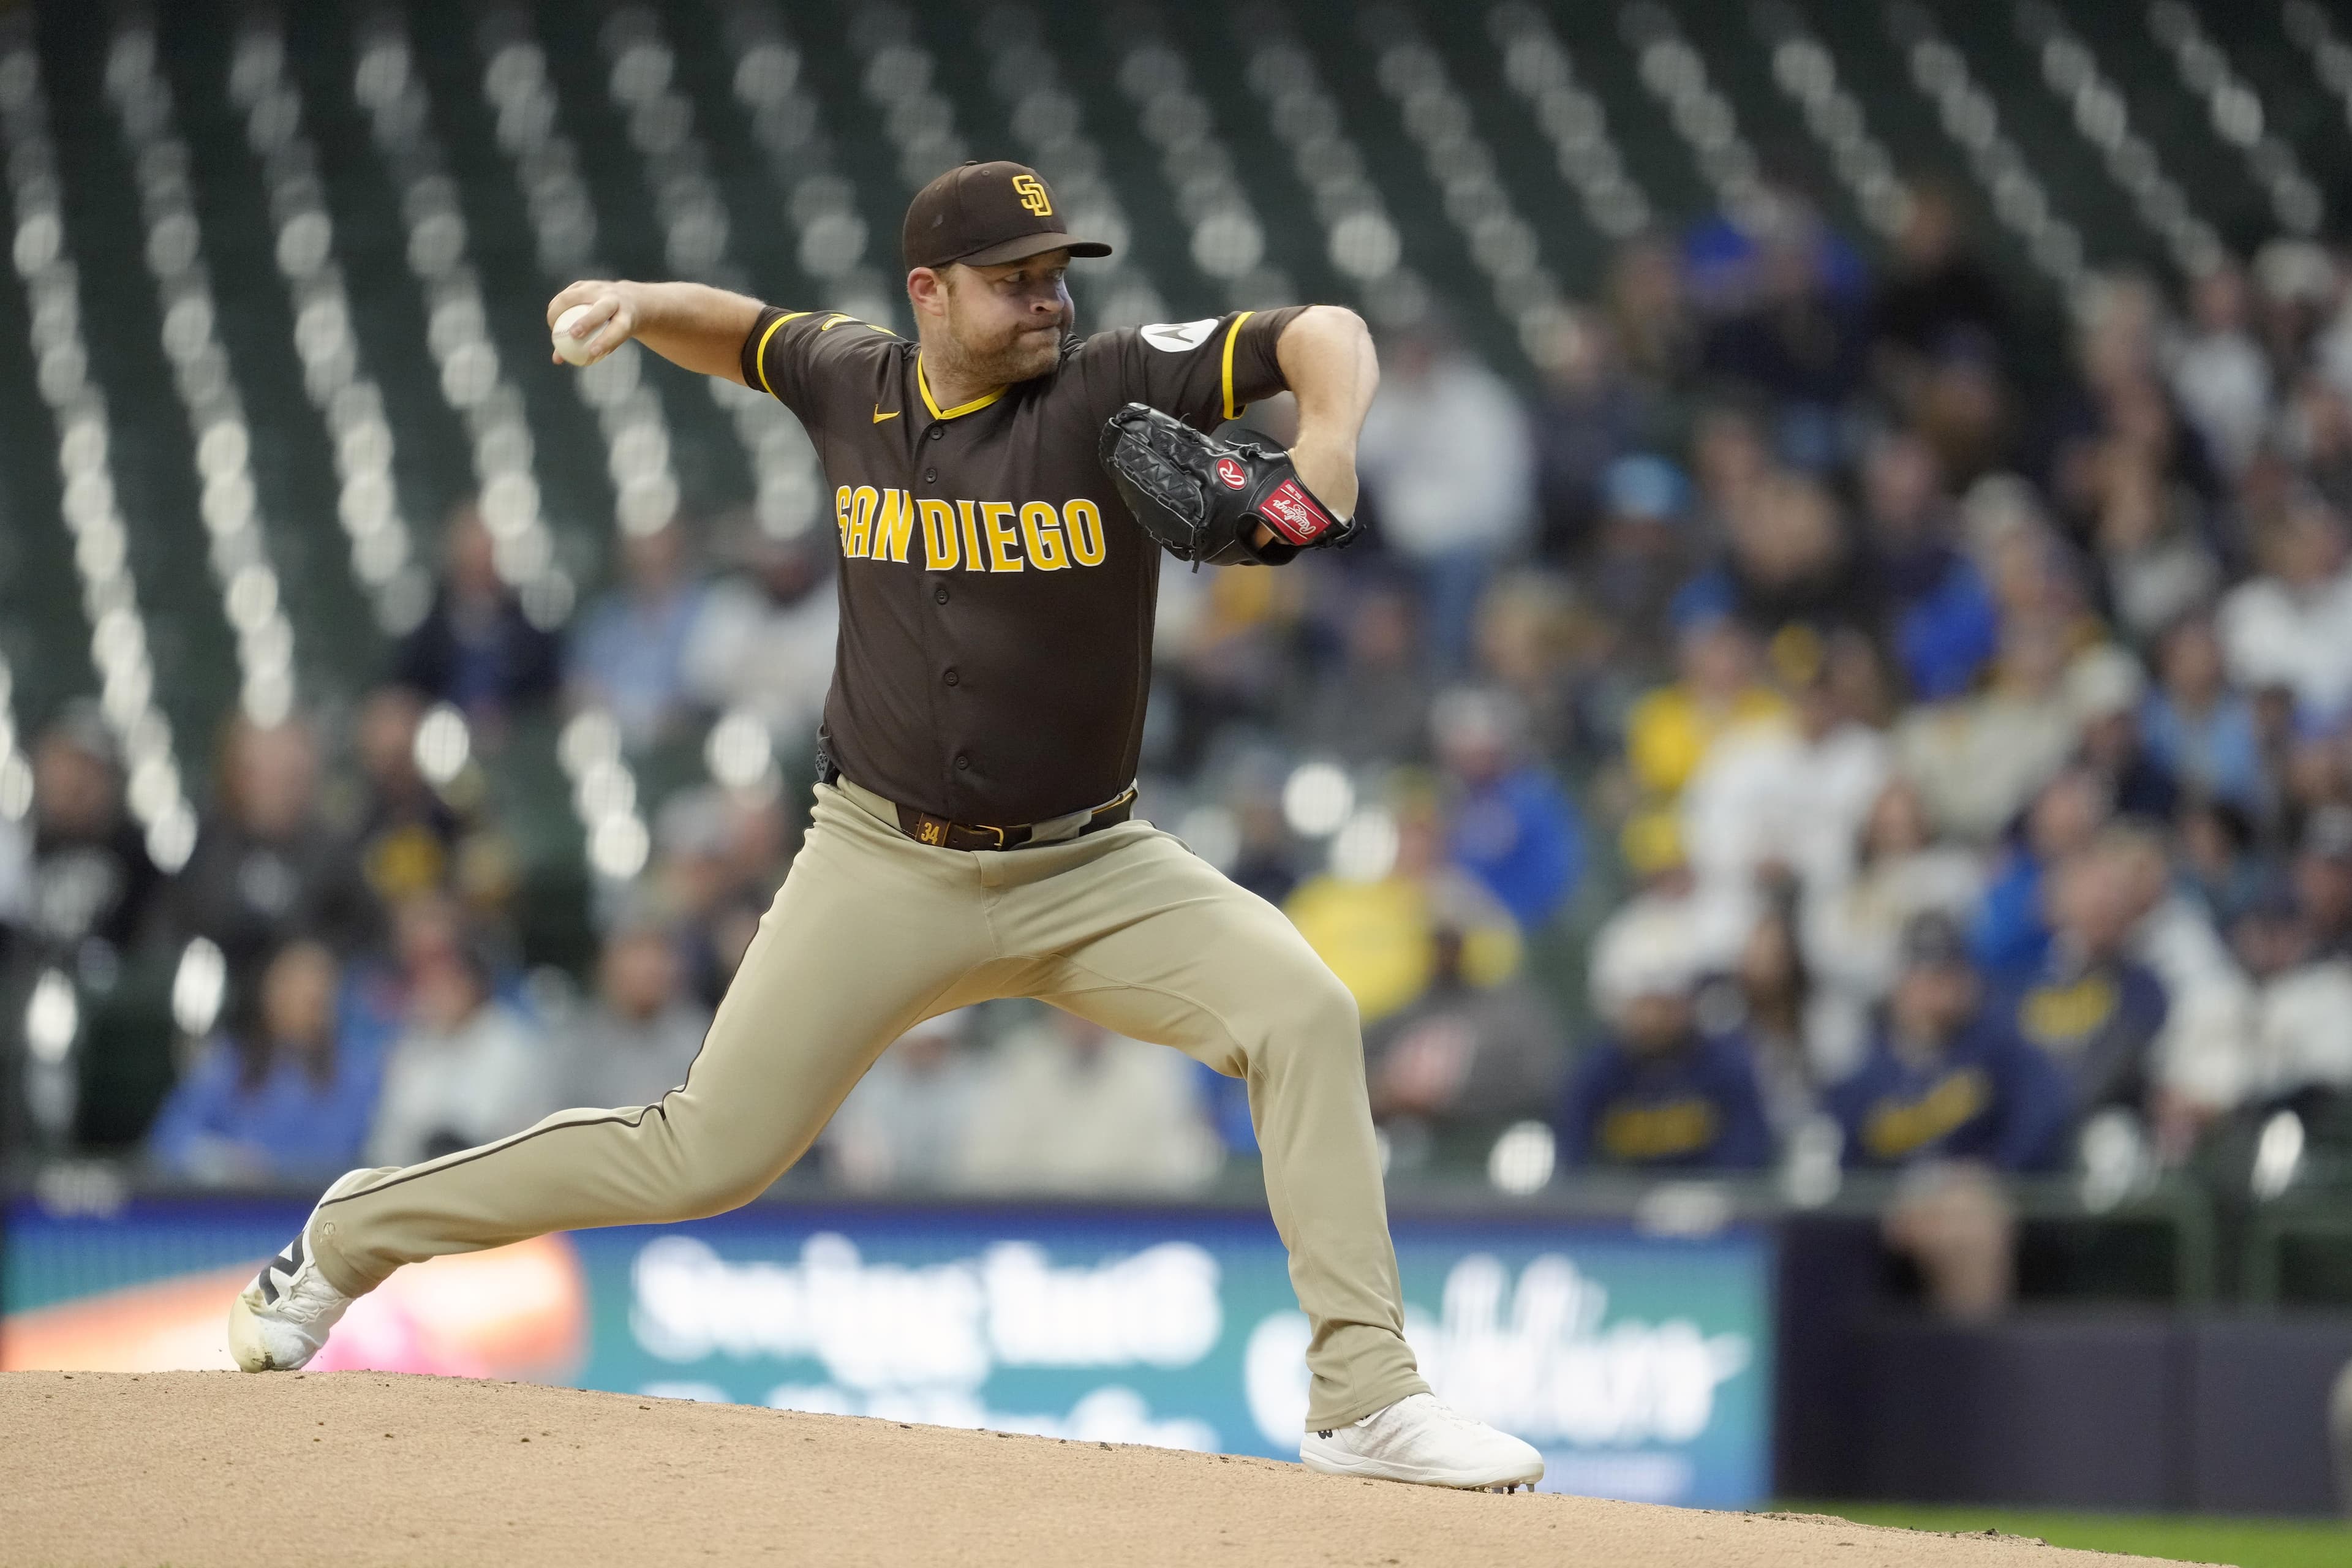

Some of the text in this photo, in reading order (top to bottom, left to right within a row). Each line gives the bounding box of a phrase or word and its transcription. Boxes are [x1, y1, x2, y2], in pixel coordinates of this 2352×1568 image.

[1012, 175, 1053, 217] SD
[1219, 461, 1245, 486] R
[835, 485, 1106, 573] SAN DIEGO
[1272, 499, 1316, 535] Rawlings
[921, 822, 940, 845] 34
